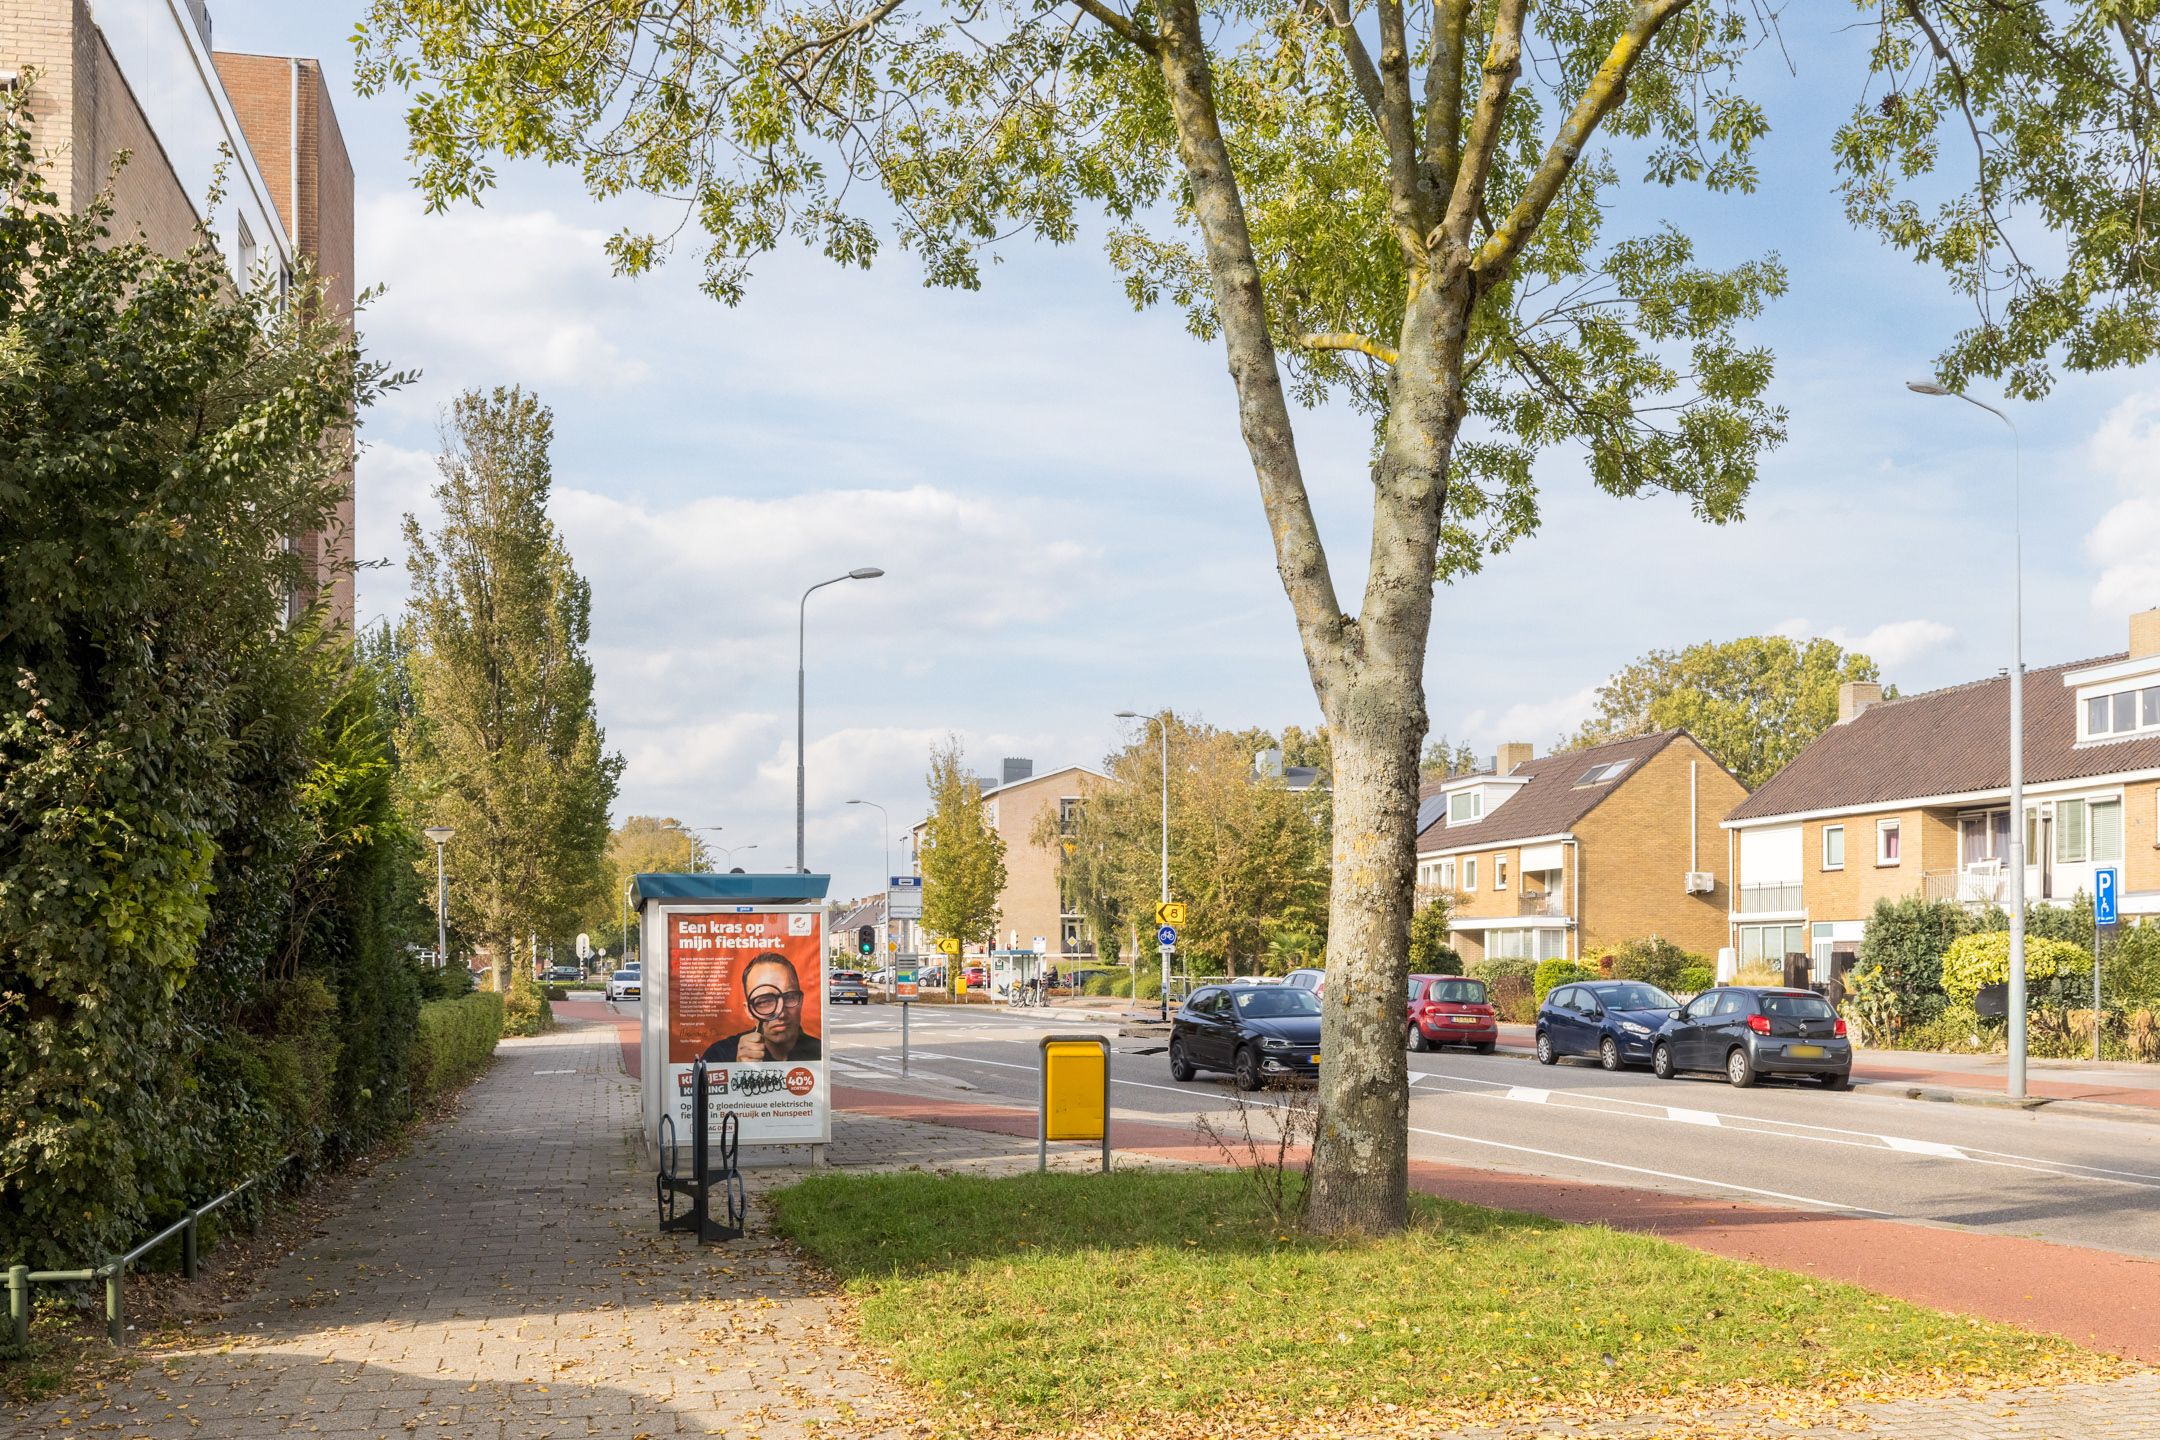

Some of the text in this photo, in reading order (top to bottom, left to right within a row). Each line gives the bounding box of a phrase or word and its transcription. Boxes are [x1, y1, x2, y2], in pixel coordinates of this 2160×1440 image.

[2099, 872, 2111, 897] P
[1170, 909, 1178, 918] 8
[679, 921, 764, 936] Een kras op
[679, 936, 785, 951] mijn fietshart.
[788, 1076, 813, 1086] 40%
[680, 1103, 692, 1111] Op
[716, 1102, 768, 1111] gloednieuwe
[770, 1100, 813, 1108] elektrische
[773, 1109, 813, 1118] Nunspeet!
